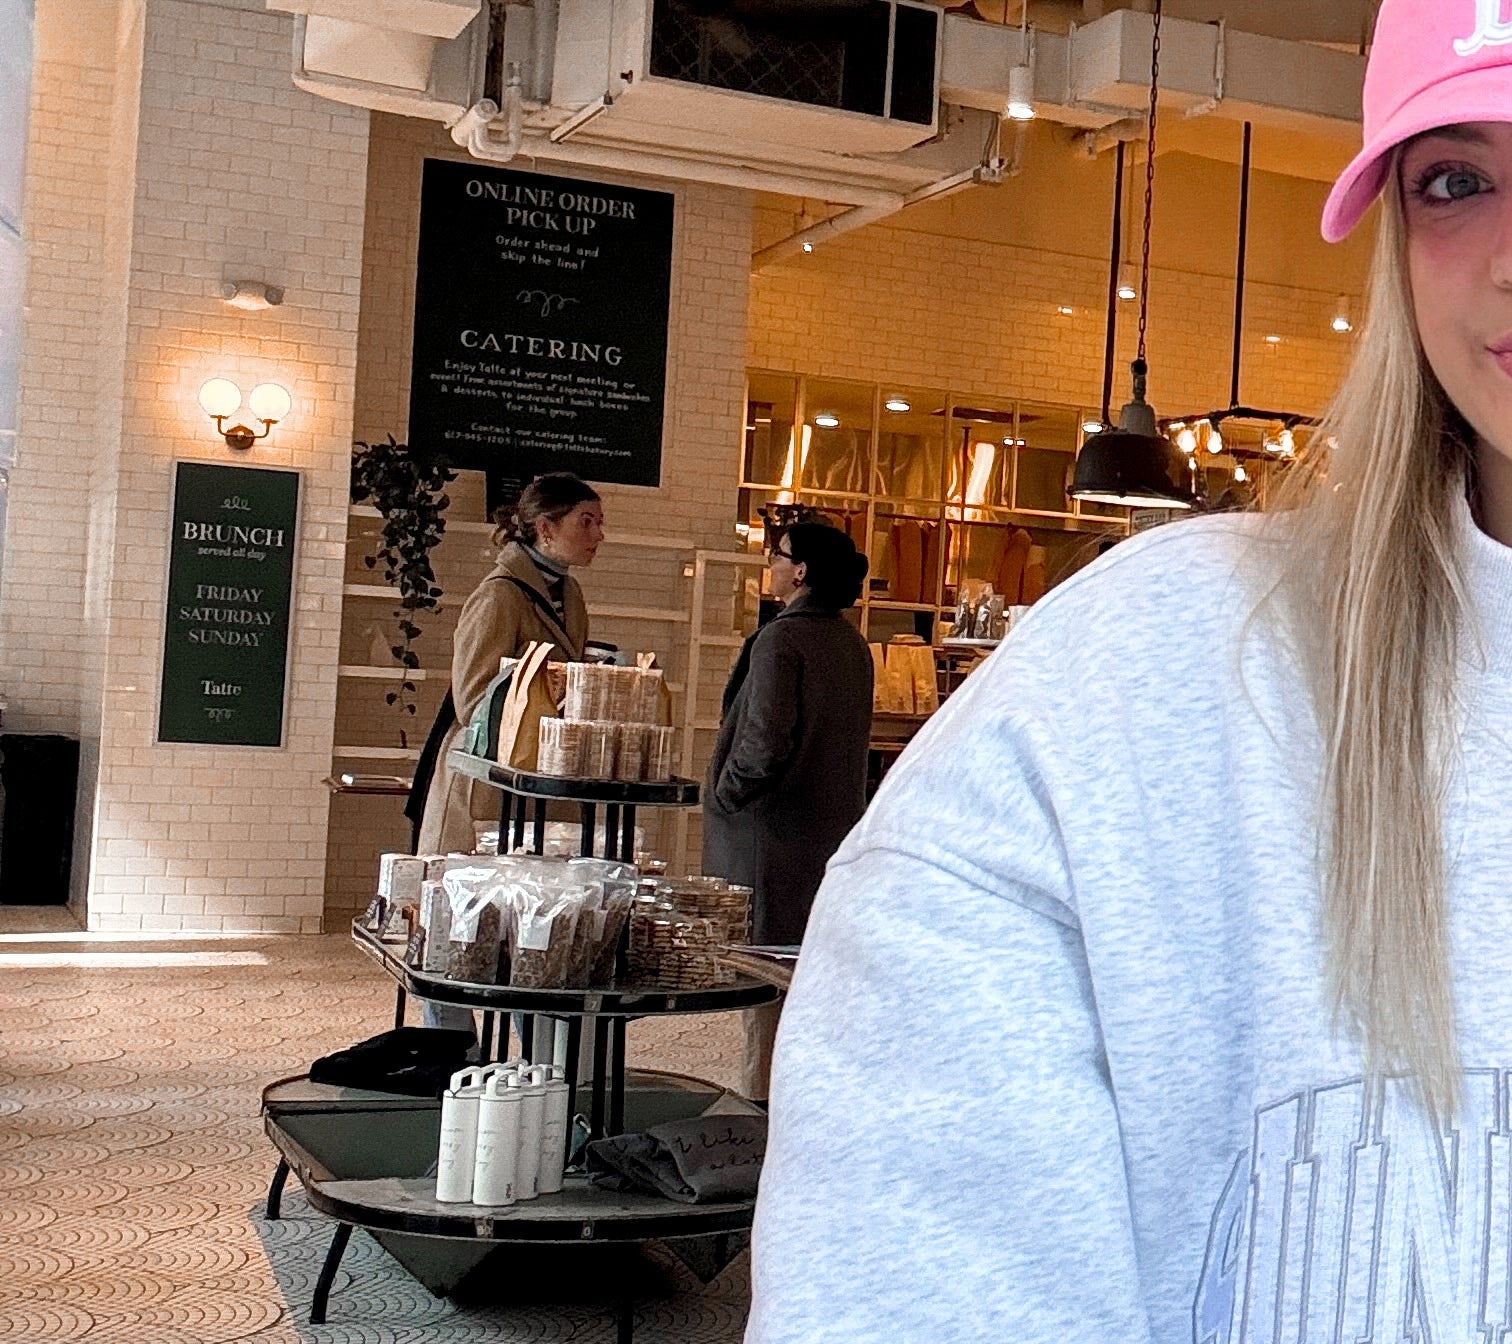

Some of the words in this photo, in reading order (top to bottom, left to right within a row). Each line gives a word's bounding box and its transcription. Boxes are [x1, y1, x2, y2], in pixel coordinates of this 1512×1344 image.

[466, 179, 554, 208] ONLINE
[558, 192, 636, 220] ORDER
[507, 208, 560, 231] PICK
[565, 216, 597, 235] UP
[495, 235, 530, 248] Order
[535, 240, 572, 254] ahead
[577, 247, 599, 258] and
[501, 250, 527, 264] skip
[533, 254, 552, 266] the
[461, 329, 622, 366] CATERING
[183, 522, 284, 547] BRUNCH
[196, 584, 264, 603] FRIDAY
[180, 606, 276, 626] SATURDAY
[189, 629, 264, 647] SUNDAY
